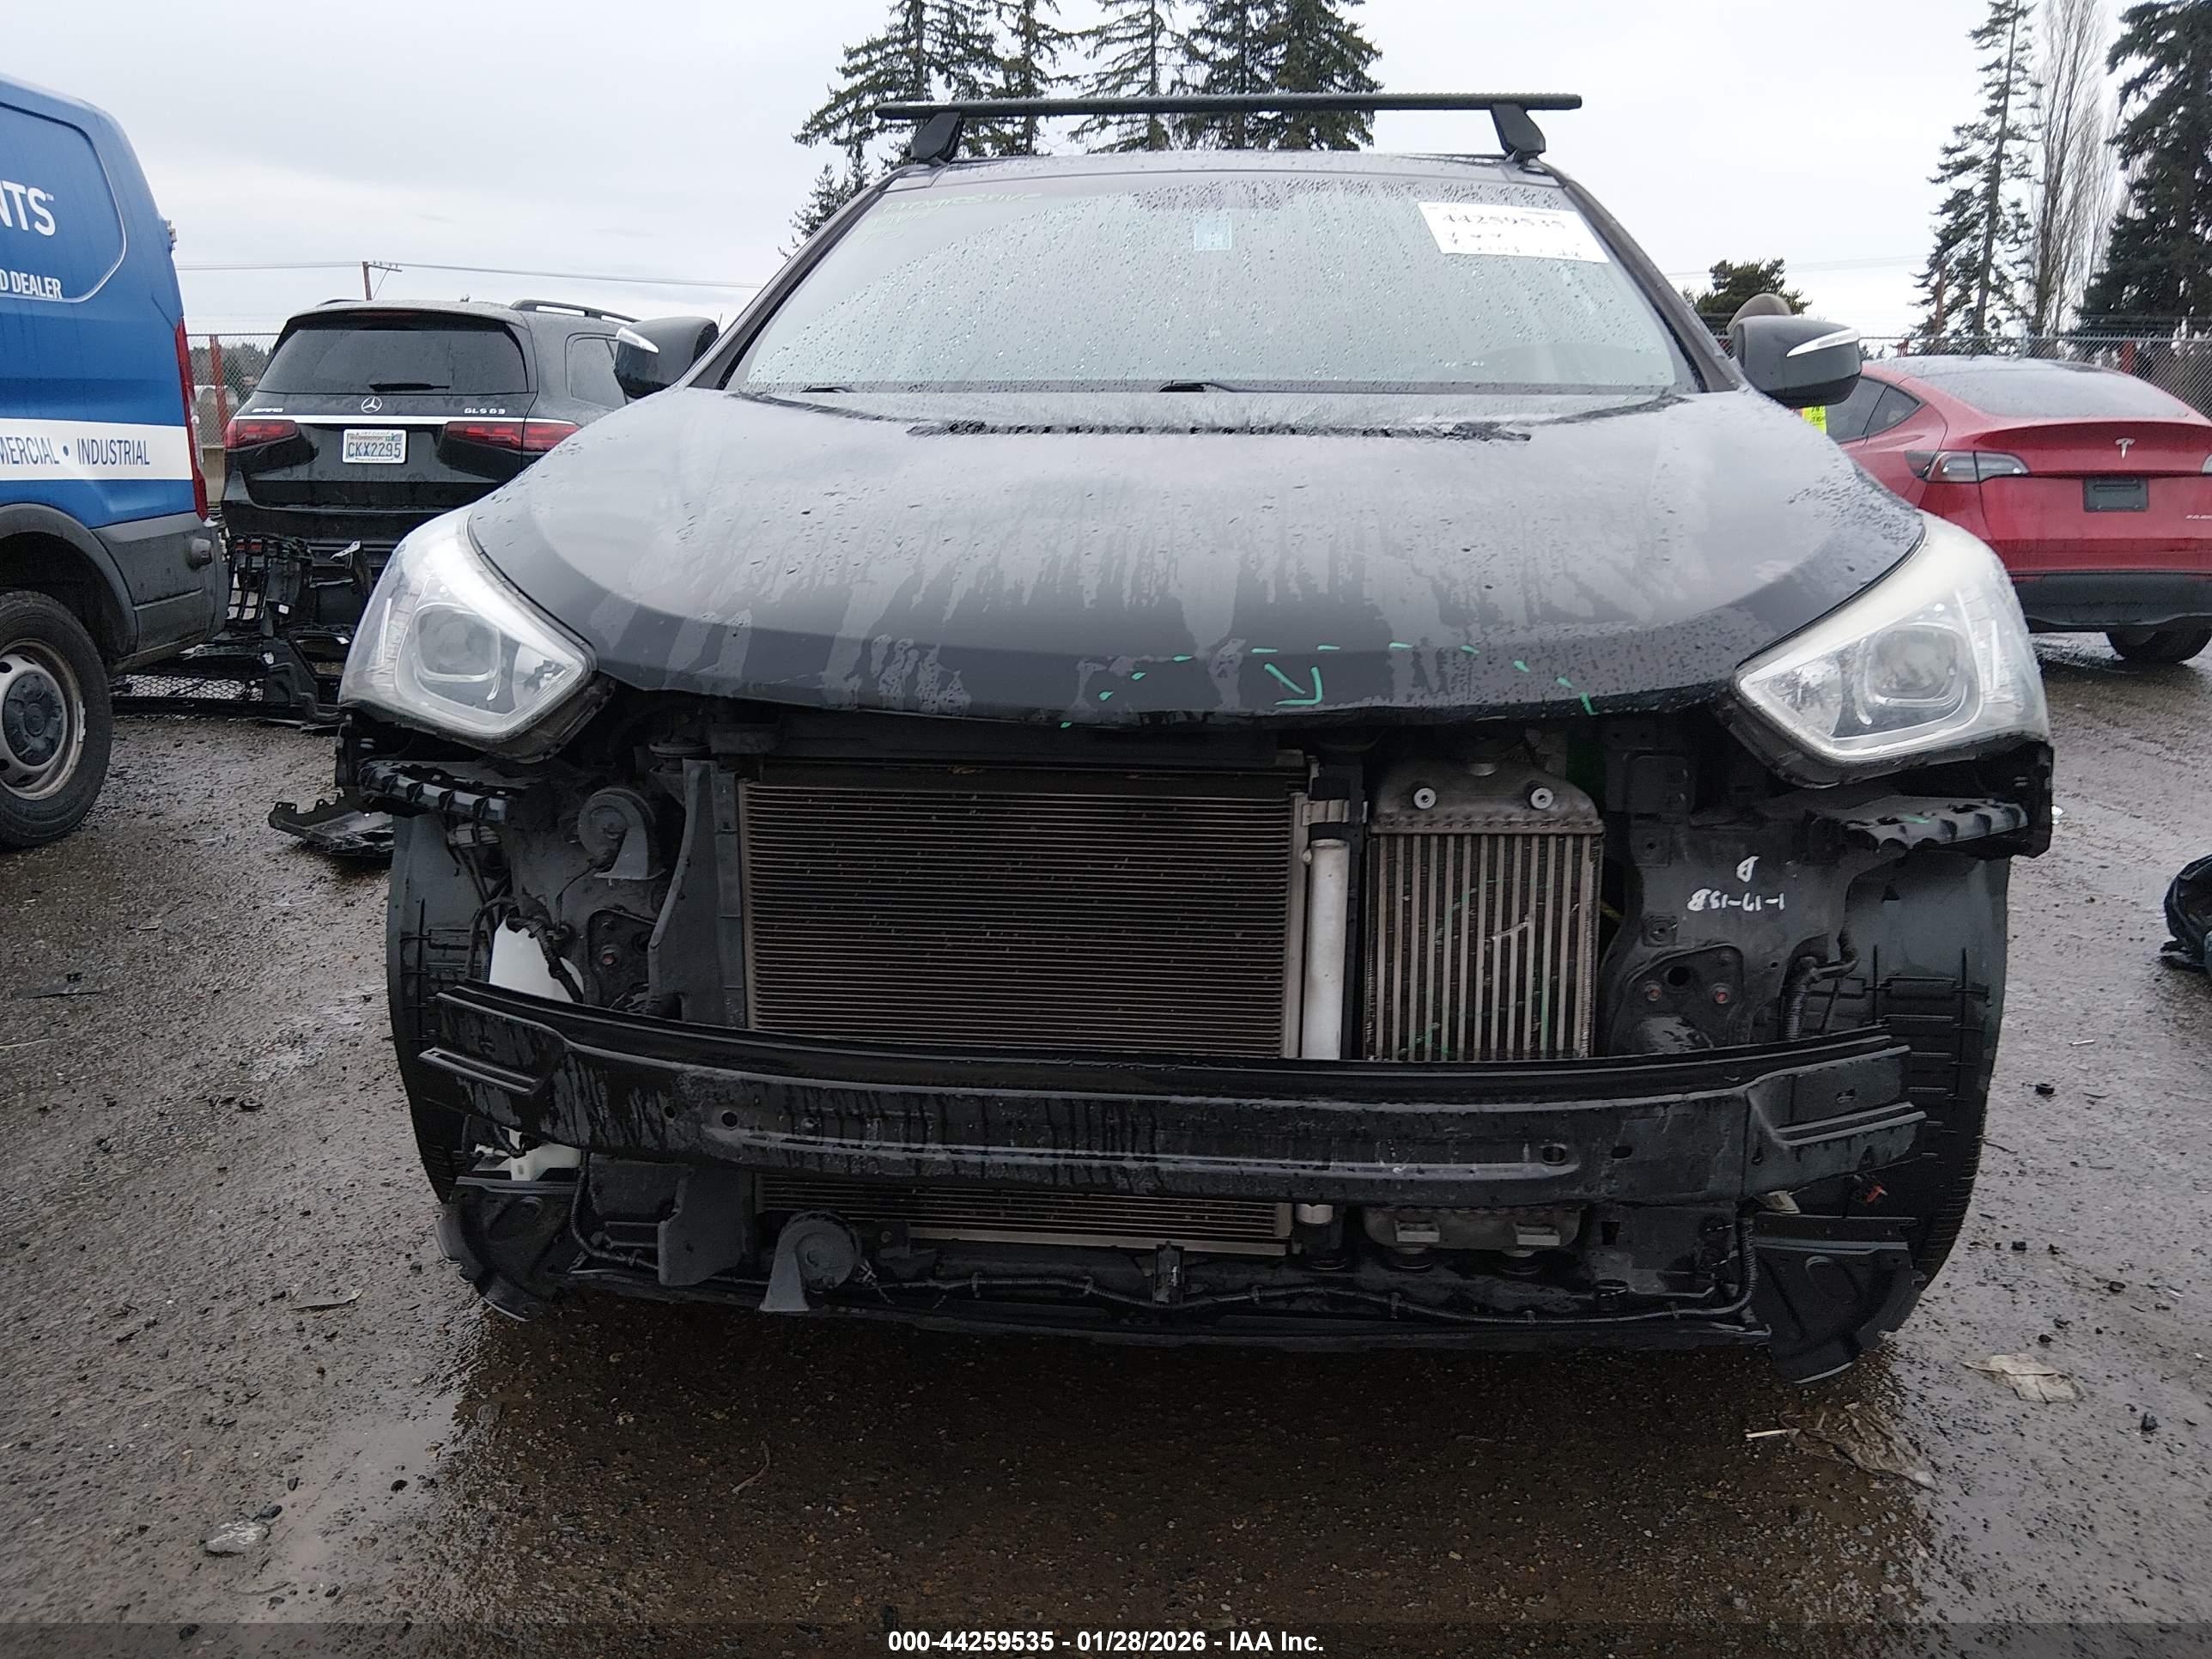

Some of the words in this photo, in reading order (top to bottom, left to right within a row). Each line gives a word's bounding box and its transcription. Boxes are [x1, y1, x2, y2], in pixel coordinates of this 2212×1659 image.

[9, 270, 63, 300] DEALER
[76, 438, 150, 465] INDUSTRIAL
[348, 441, 403, 459] CKX2295
